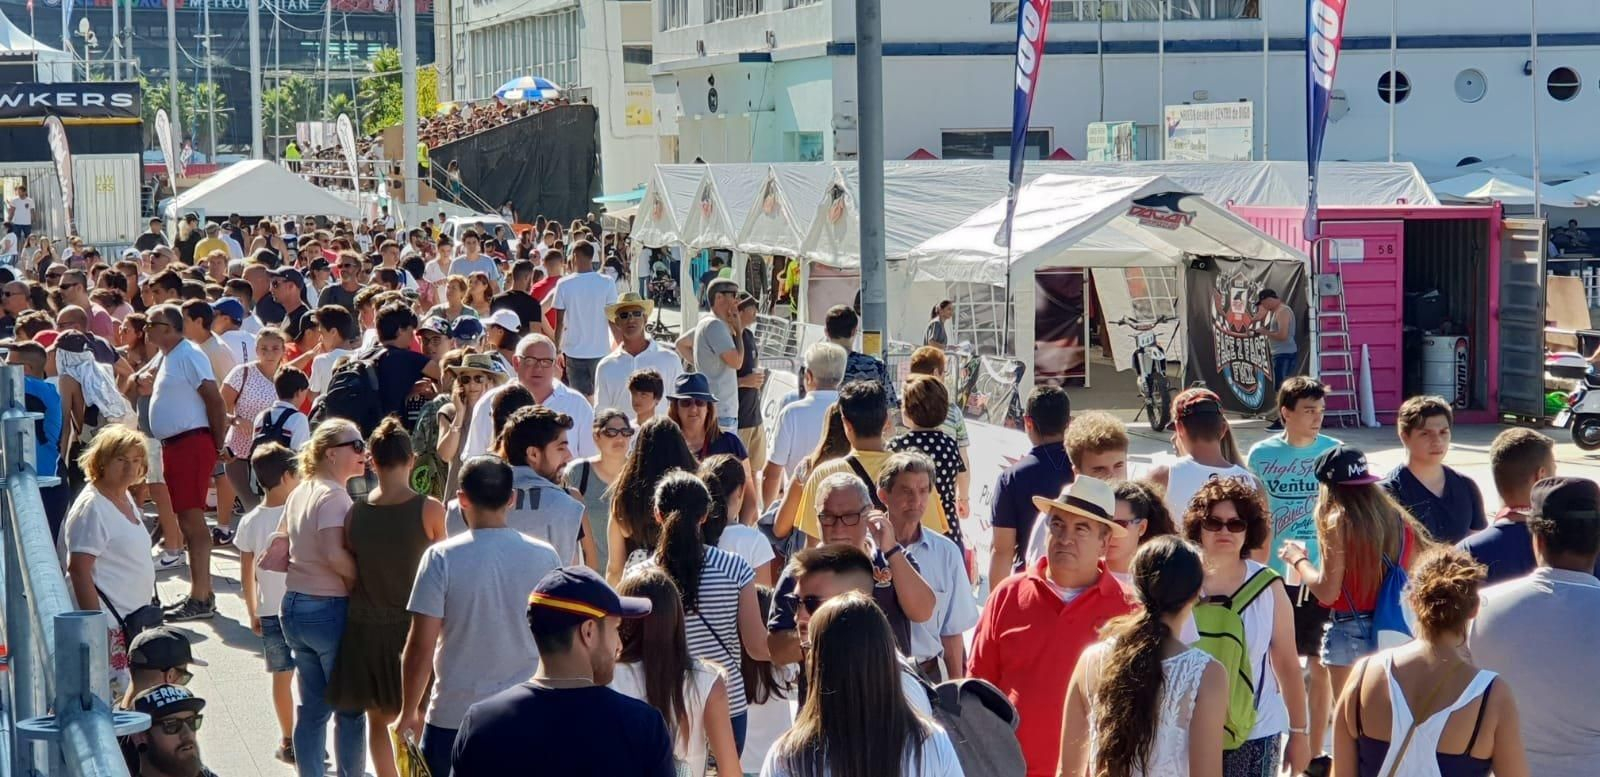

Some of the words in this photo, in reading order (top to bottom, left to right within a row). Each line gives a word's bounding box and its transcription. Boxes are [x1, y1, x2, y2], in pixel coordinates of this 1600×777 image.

[1016, 0, 1043, 95] 100
[1312, 0, 1340, 91] 100
[1215, 328, 1237, 366] FACE
[1236, 337, 1244, 360] 2
[1243, 335, 1269, 371] FACE
[1258, 458, 1297, 478] High
[1297, 457, 1316, 477] Sp
